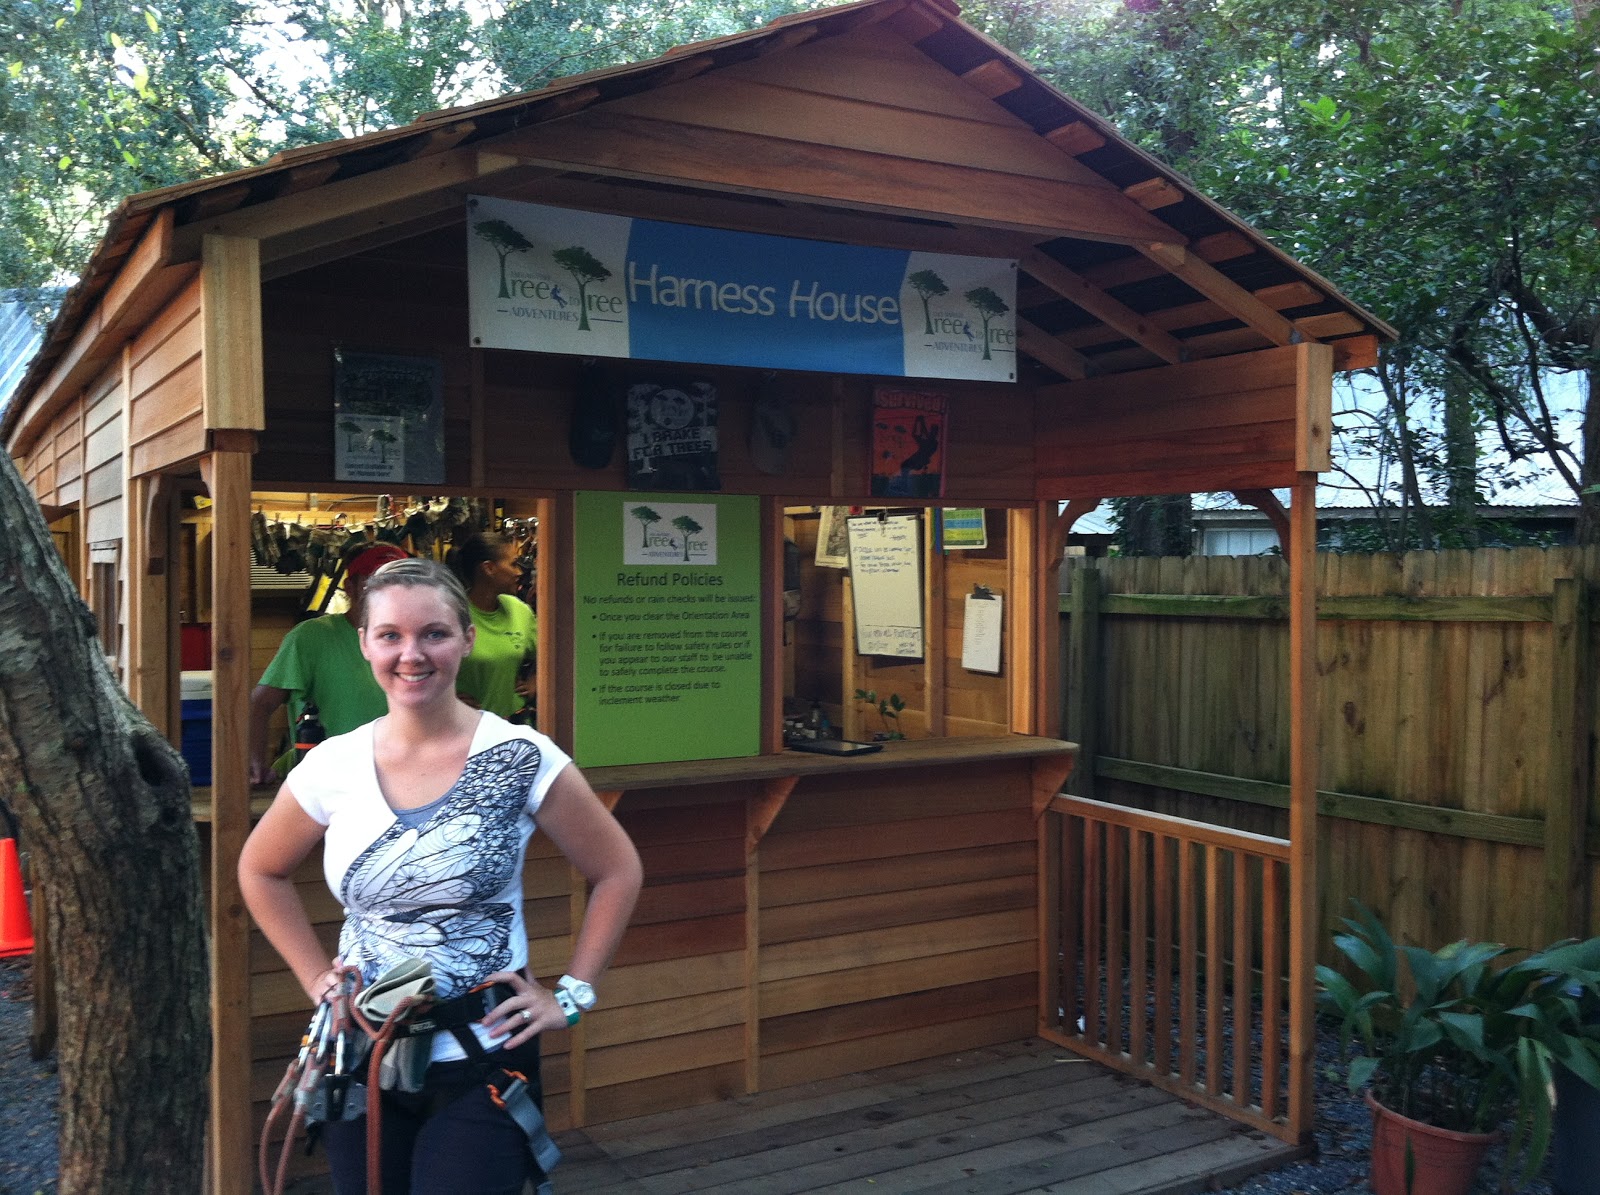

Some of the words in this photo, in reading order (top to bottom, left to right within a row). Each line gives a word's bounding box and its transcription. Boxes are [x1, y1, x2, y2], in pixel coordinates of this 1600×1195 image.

[628, 261, 776, 316] Harness
[789, 279, 899, 325] House
[510, 306, 579, 322] ADVENTURES
[652, 429, 700, 443] BRAKE
[666, 440, 712, 454] TREES
[617, 572, 668, 586] Refund
[672, 573, 723, 587] Policies
[583, 595, 596, 604] No
[599, 595, 634, 604] refunds
[667, 595, 696, 603] checks
[698, 594, 712, 603] will
[715, 595, 725, 603] be
[599, 612, 622, 622] Once
[624, 614, 641, 623] you
[642, 612, 663, 621] clear
[666, 612, 679, 620] the
[682, 611, 729, 620] Orientation
[730, 611, 750, 619] Area
[608, 634, 624, 642] you
[643, 631, 681, 640] removed
[683, 630, 703, 639] from
[705, 630, 719, 638] the
[721, 630, 748, 638] course
[599, 644, 613, 653] for
[615, 643, 642, 652] failure
[656, 642, 682, 651] follow
[684, 642, 709, 651] safety
[712, 641, 731, 650] rules
[599, 657, 616, 665] you
[618, 656, 648, 665] appear
[651, 655, 660, 663] to
[662, 655, 677, 663] our
[679, 653, 697, 662] staff
[712, 653, 723, 661] be
[725, 652, 752, 661] unable
[599, 668, 609, 677] to
[611, 667, 636, 677] safely
[639, 666, 678, 676] complete
[680, 665, 695, 674] the
[608, 684, 622, 693] the
[624, 684, 654, 693] course
[665, 682, 691, 691] closed
[693, 681, 709, 690] due
[711, 681, 721, 689] to
